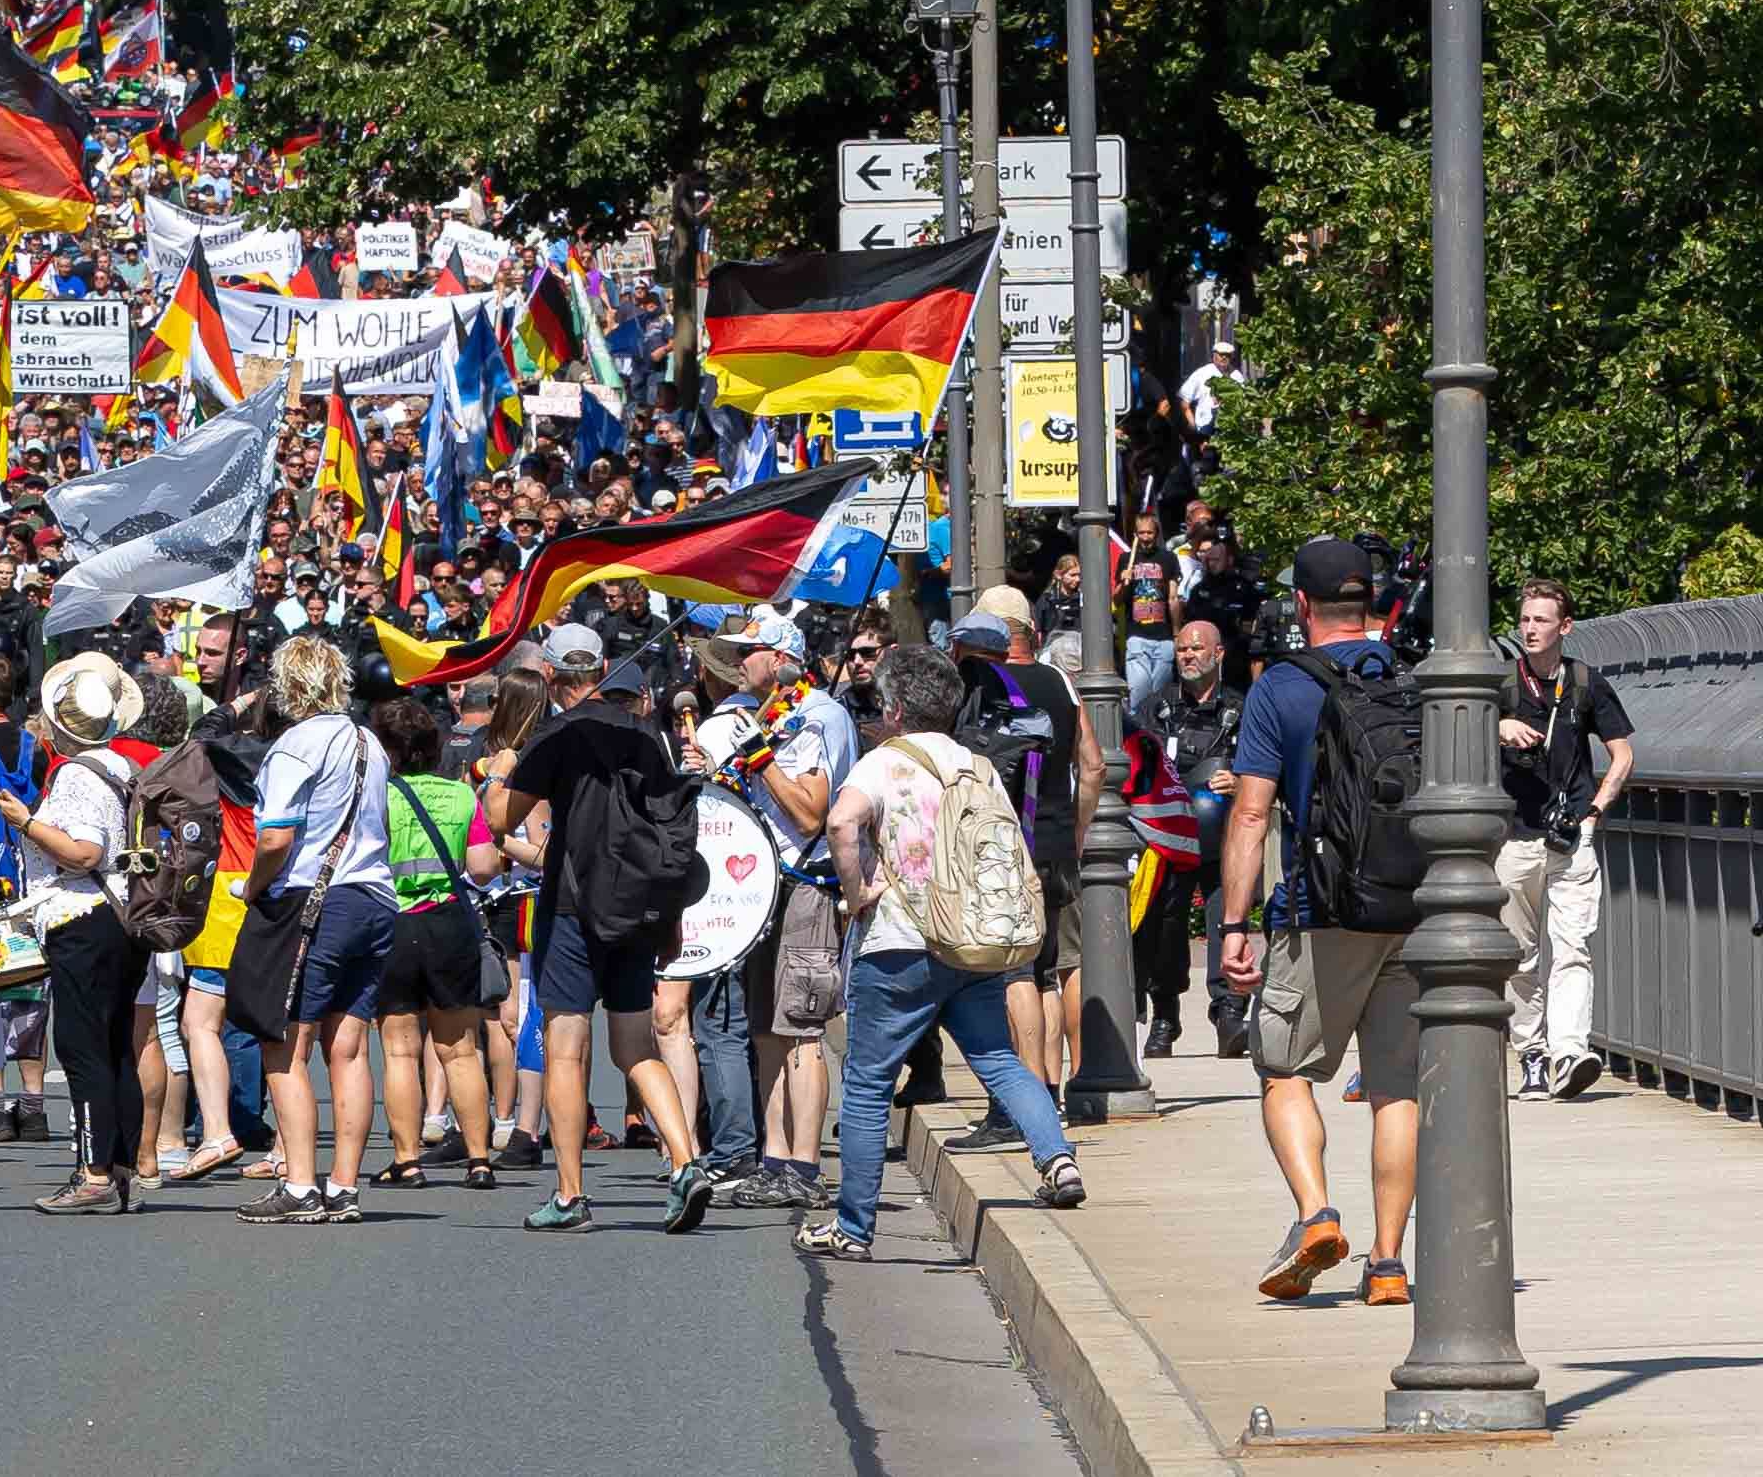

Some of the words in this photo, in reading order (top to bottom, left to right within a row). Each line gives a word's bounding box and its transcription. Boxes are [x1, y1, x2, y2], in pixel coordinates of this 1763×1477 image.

[362, 233, 410, 244] POLITIKER
[364, 248, 411, 259] HAFTUNG
[1005, 294, 1029, 312] für
[17, 305, 51, 325] ist
[60, 306, 120, 327] voll!
[250, 303, 318, 346] ZUM
[336, 310, 432, 348] WOHLE
[20, 333, 57, 346] dem
[18, 372, 124, 388] Wirtschaft!
